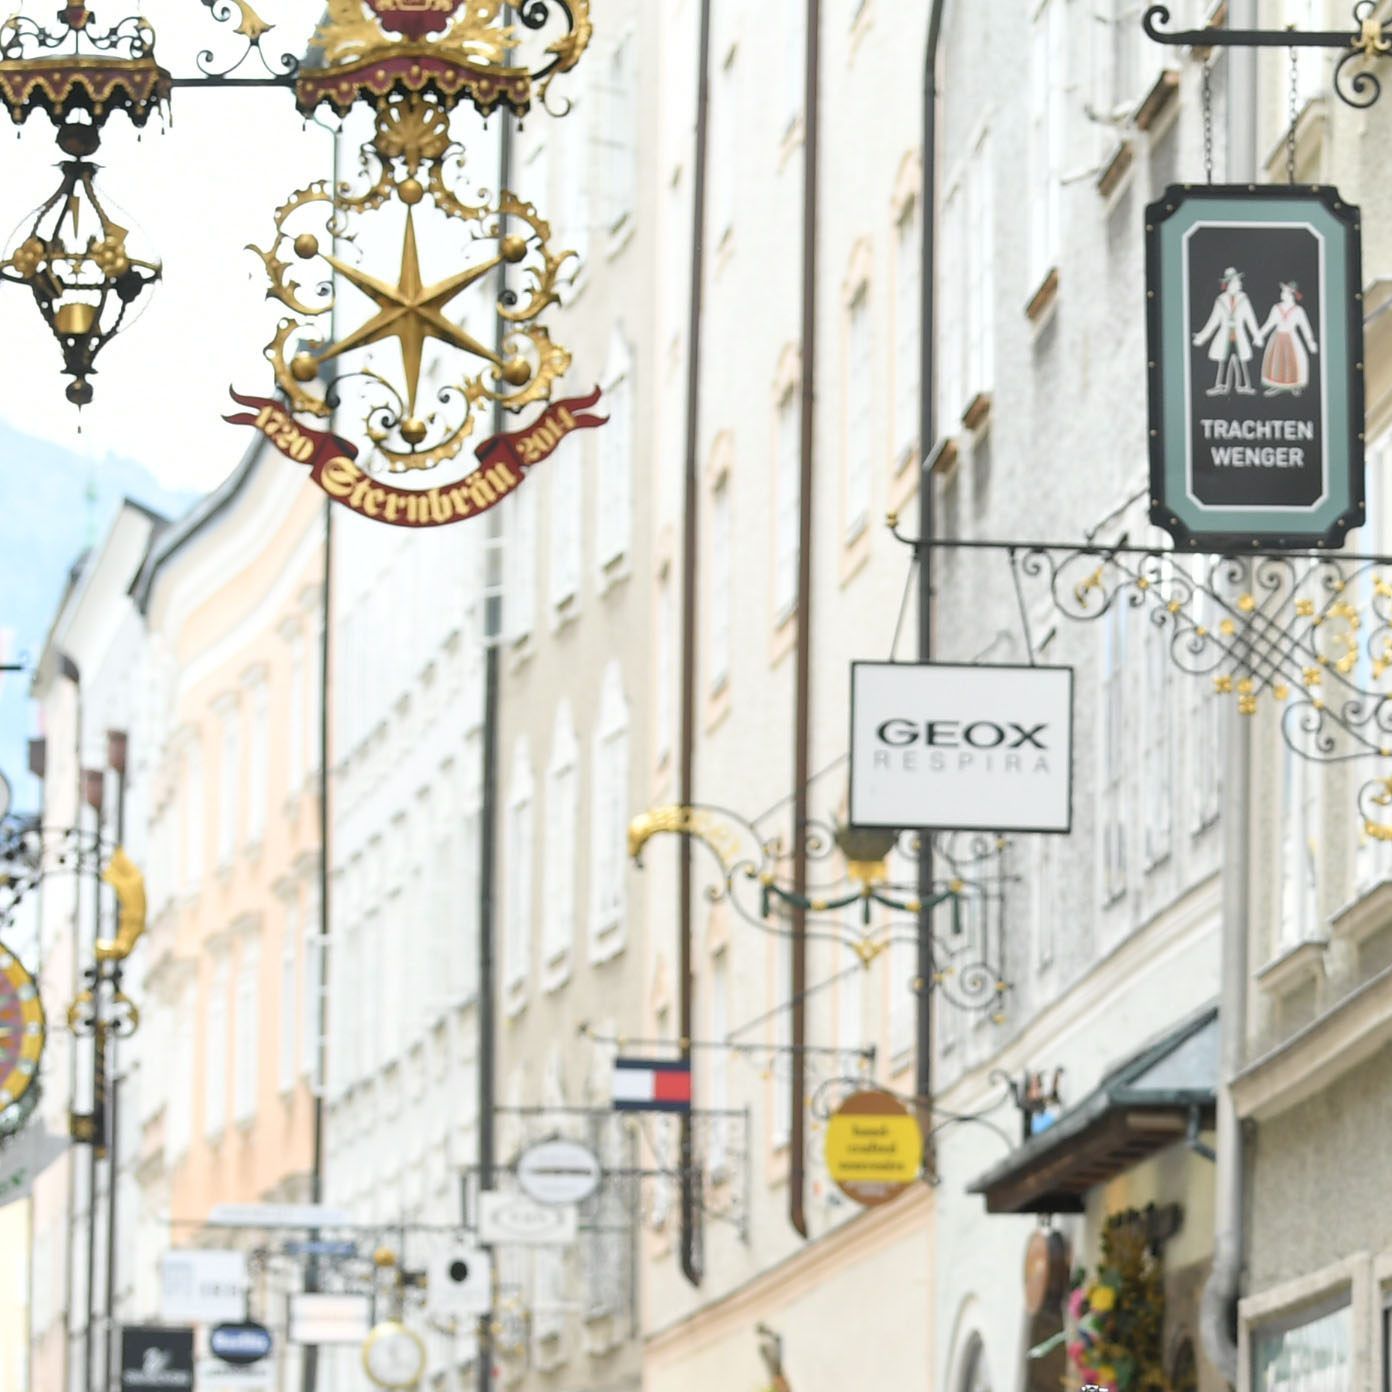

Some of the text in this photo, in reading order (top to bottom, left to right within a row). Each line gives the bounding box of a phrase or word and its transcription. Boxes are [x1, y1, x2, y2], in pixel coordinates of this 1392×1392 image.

[255, 405, 314, 461] 1720
[1199, 418, 1314, 441] TRACHTEN
[1210, 445, 1305, 468] WENGER
[321, 456, 518, 525] Sternbräu
[876, 717, 1050, 750] GEOX
[873, 749, 1051, 774] RESPIRA
